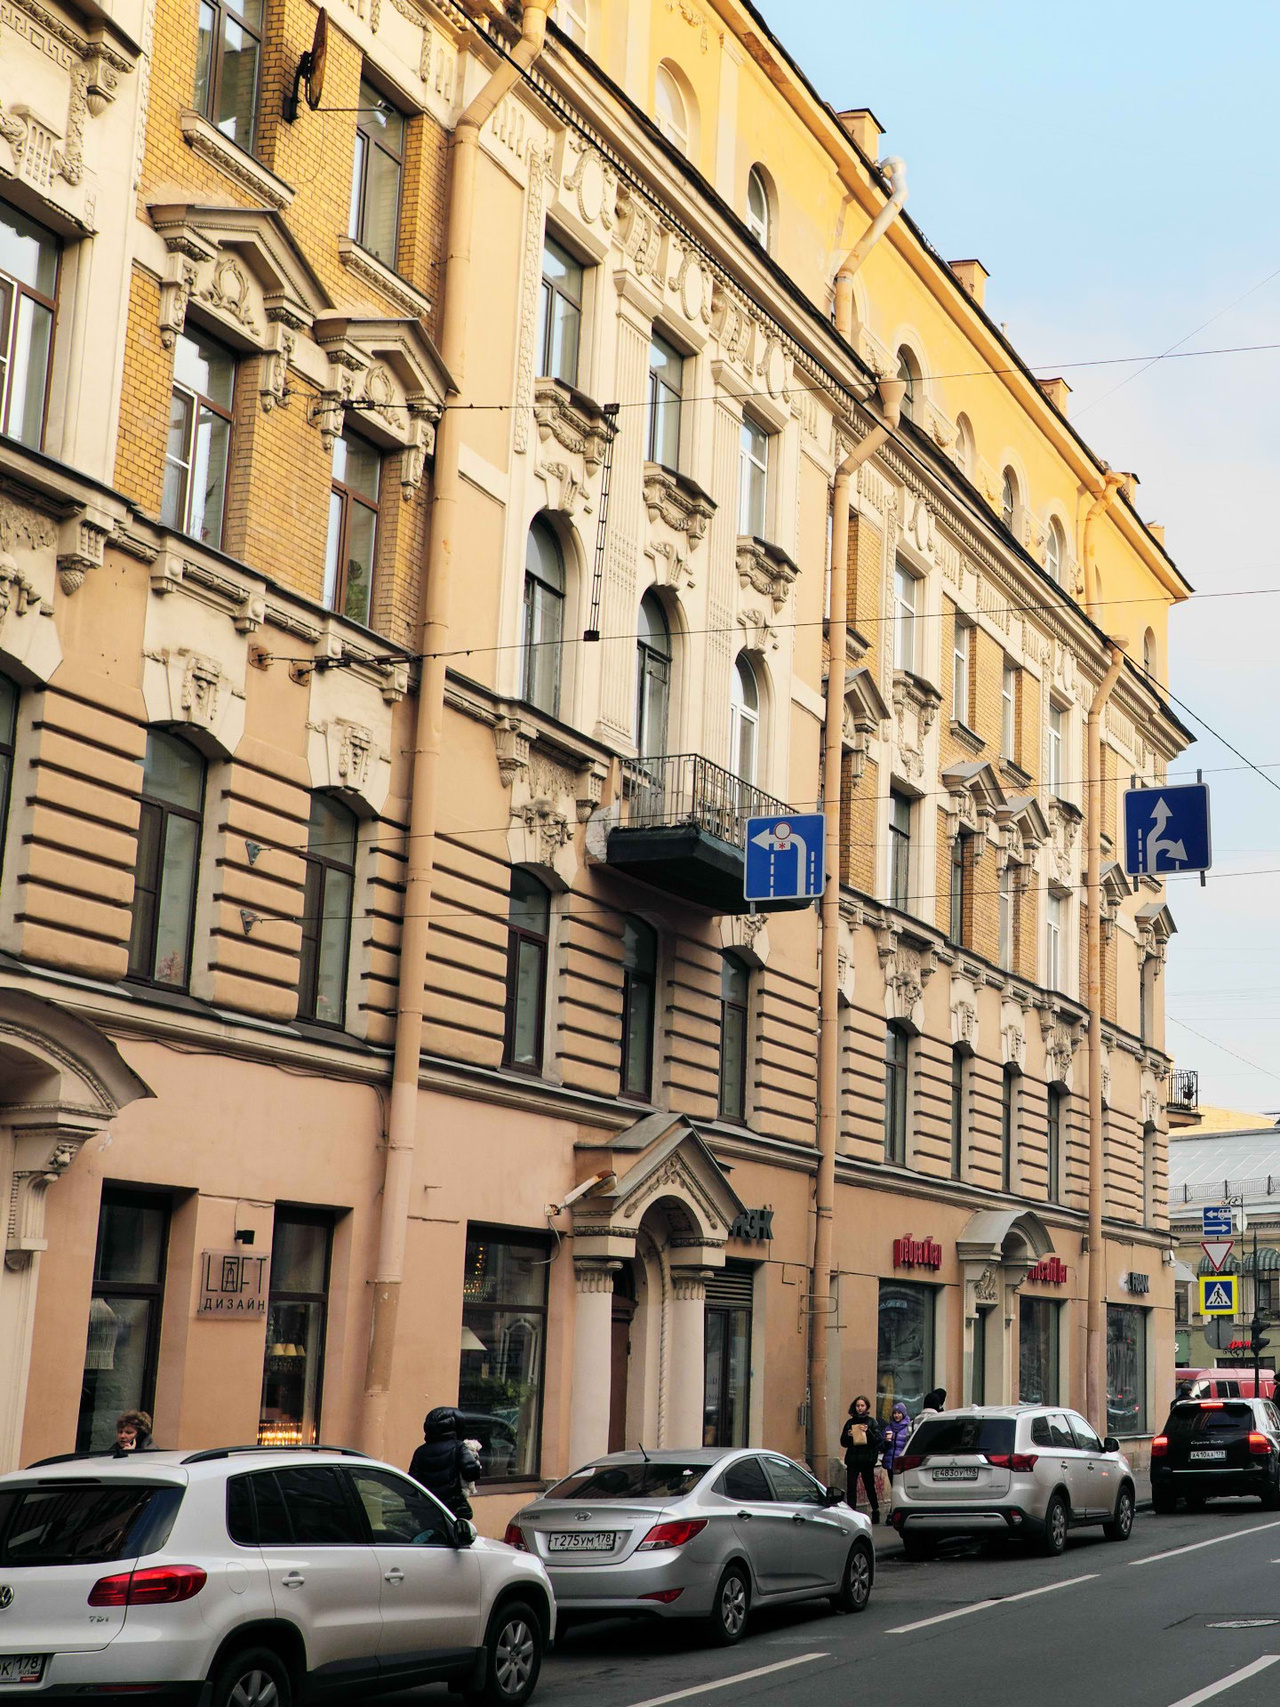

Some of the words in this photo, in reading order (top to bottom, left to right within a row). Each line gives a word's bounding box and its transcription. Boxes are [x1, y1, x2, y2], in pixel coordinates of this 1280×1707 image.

[206, 1254, 267, 1294] LOFT
[204, 1297, 265, 1311] ДИЗАЙН
[553, 1534, 594, 1547] Т275УМ
[595, 1533, 611, 1544] 178
[18, 1656, 38, 1670] 178
